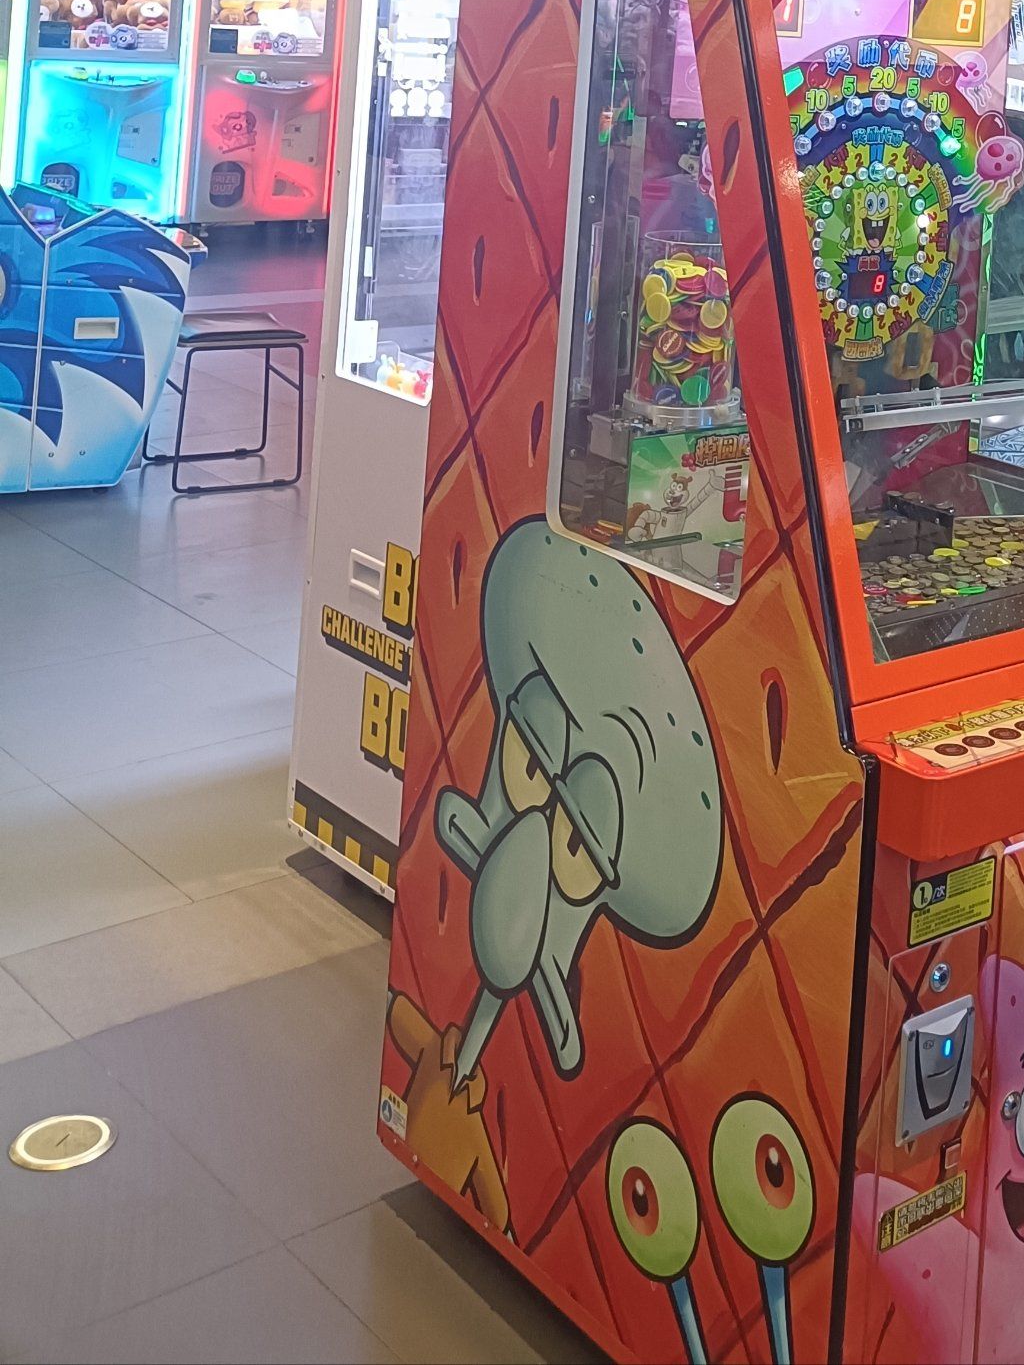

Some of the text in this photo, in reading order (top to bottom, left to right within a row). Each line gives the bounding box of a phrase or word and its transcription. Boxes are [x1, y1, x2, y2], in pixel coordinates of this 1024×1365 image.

[956, 0, 977, 34] 8
[825, 38, 940, 77] 奖励代币
[806, 88, 829, 112] 10
[842, 75, 857, 97] 5
[869, 66, 897, 91] 20
[906, 77, 921, 99] 5
[928, 91, 950, 114] 10
[952, 117, 966, 141] 5
[874, 274, 884, 292] 8
[382, 542, 420, 637] B
[321, 604, 407, 676] CHALLENGE
